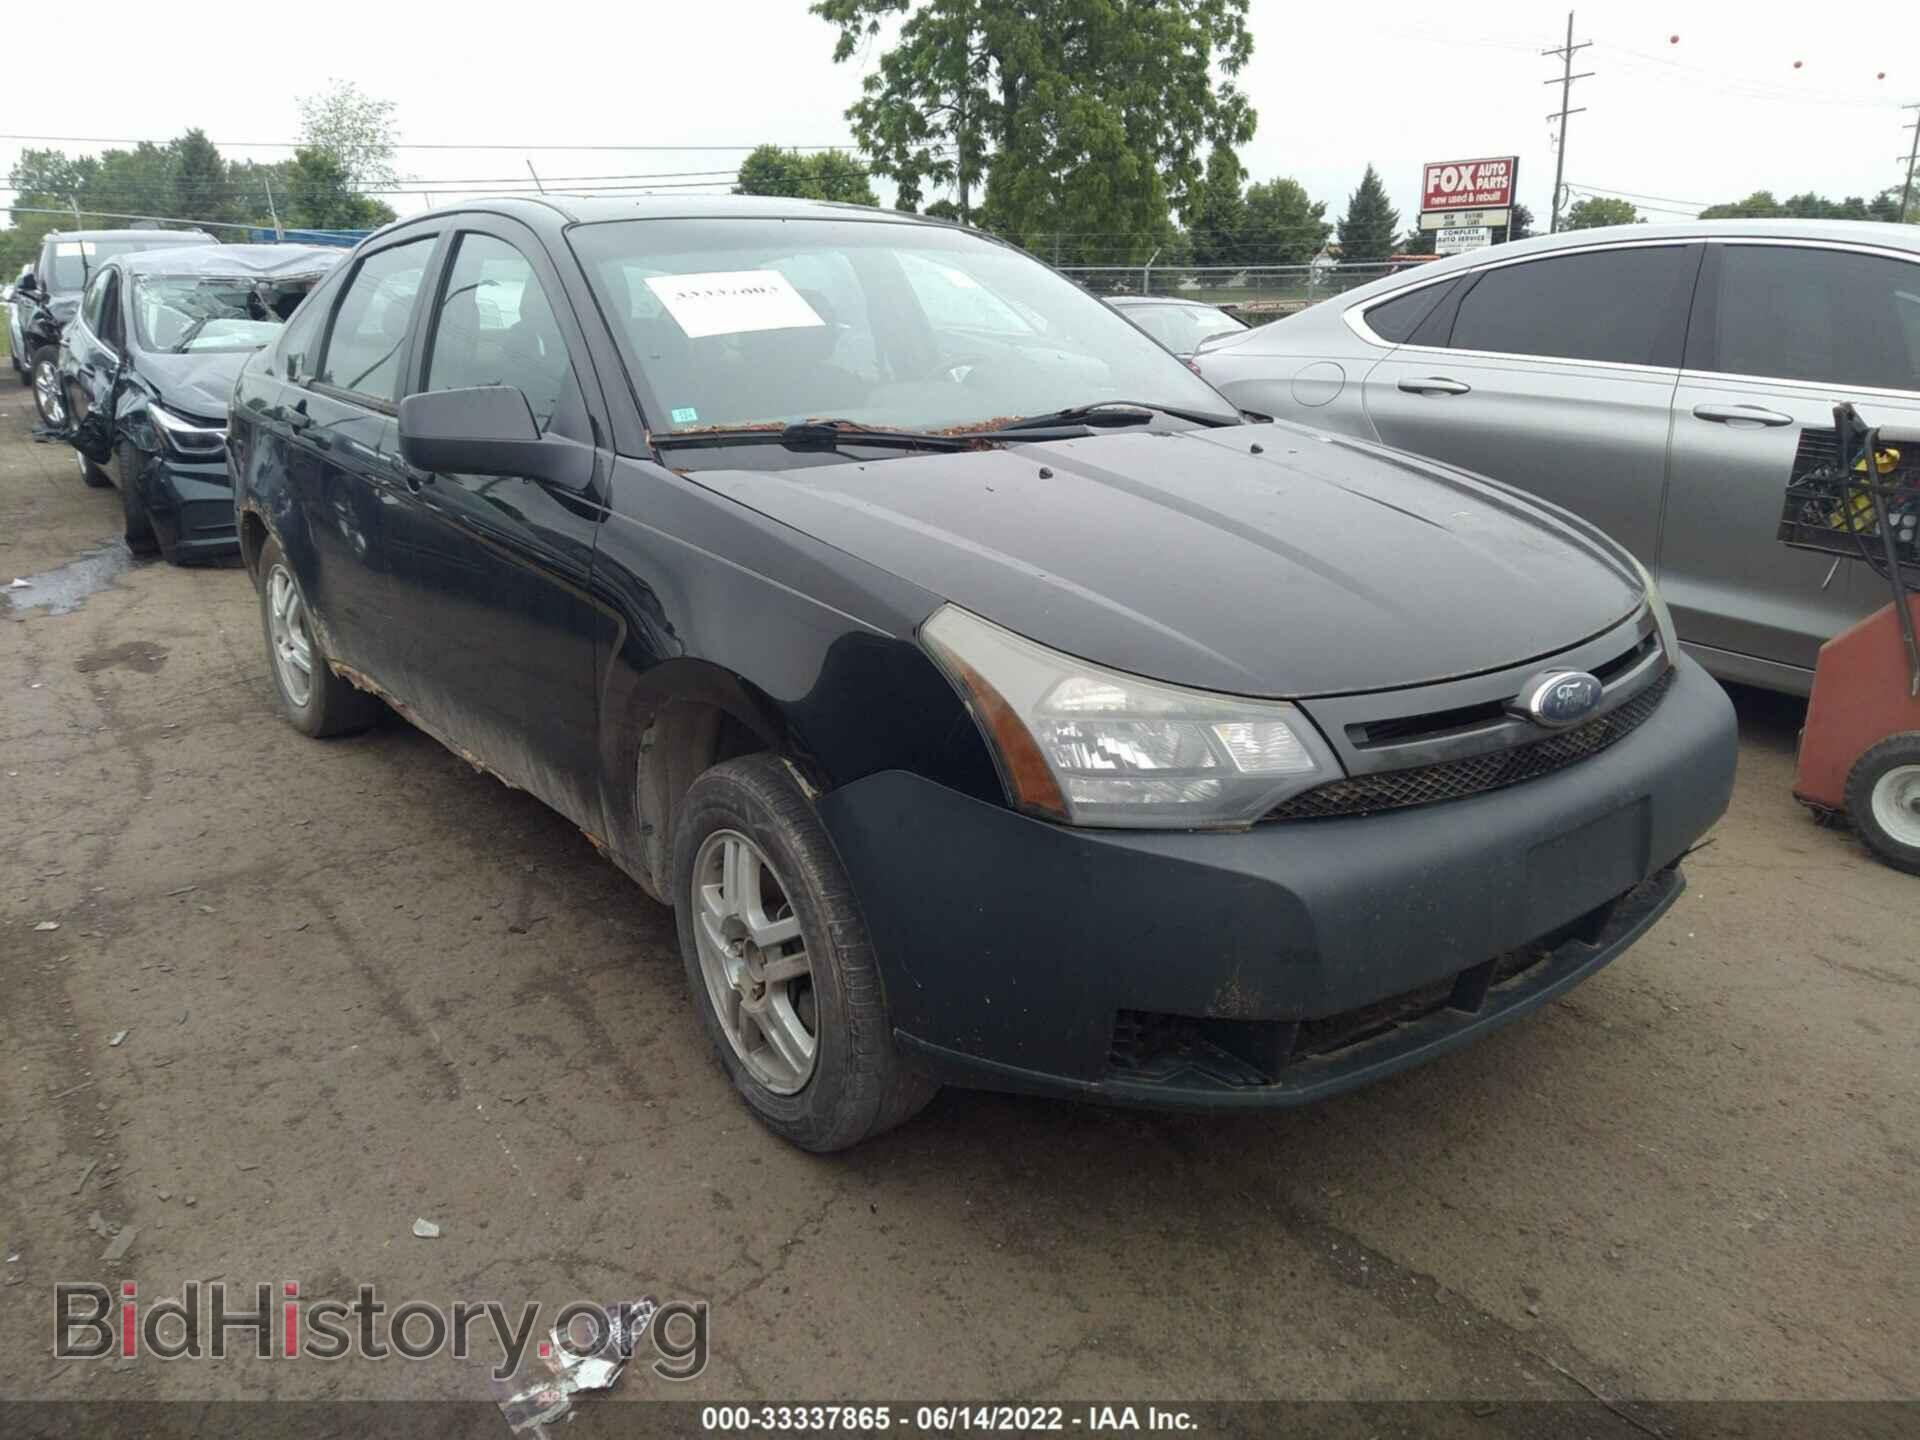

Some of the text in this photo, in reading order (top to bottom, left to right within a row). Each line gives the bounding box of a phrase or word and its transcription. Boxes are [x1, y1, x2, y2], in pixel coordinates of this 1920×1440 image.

[1477, 163, 1506, 176] AUTO
[1427, 166, 1476, 193] FOX
[1476, 176, 1508, 189] PARTS
[1431, 196, 1447, 205] new
